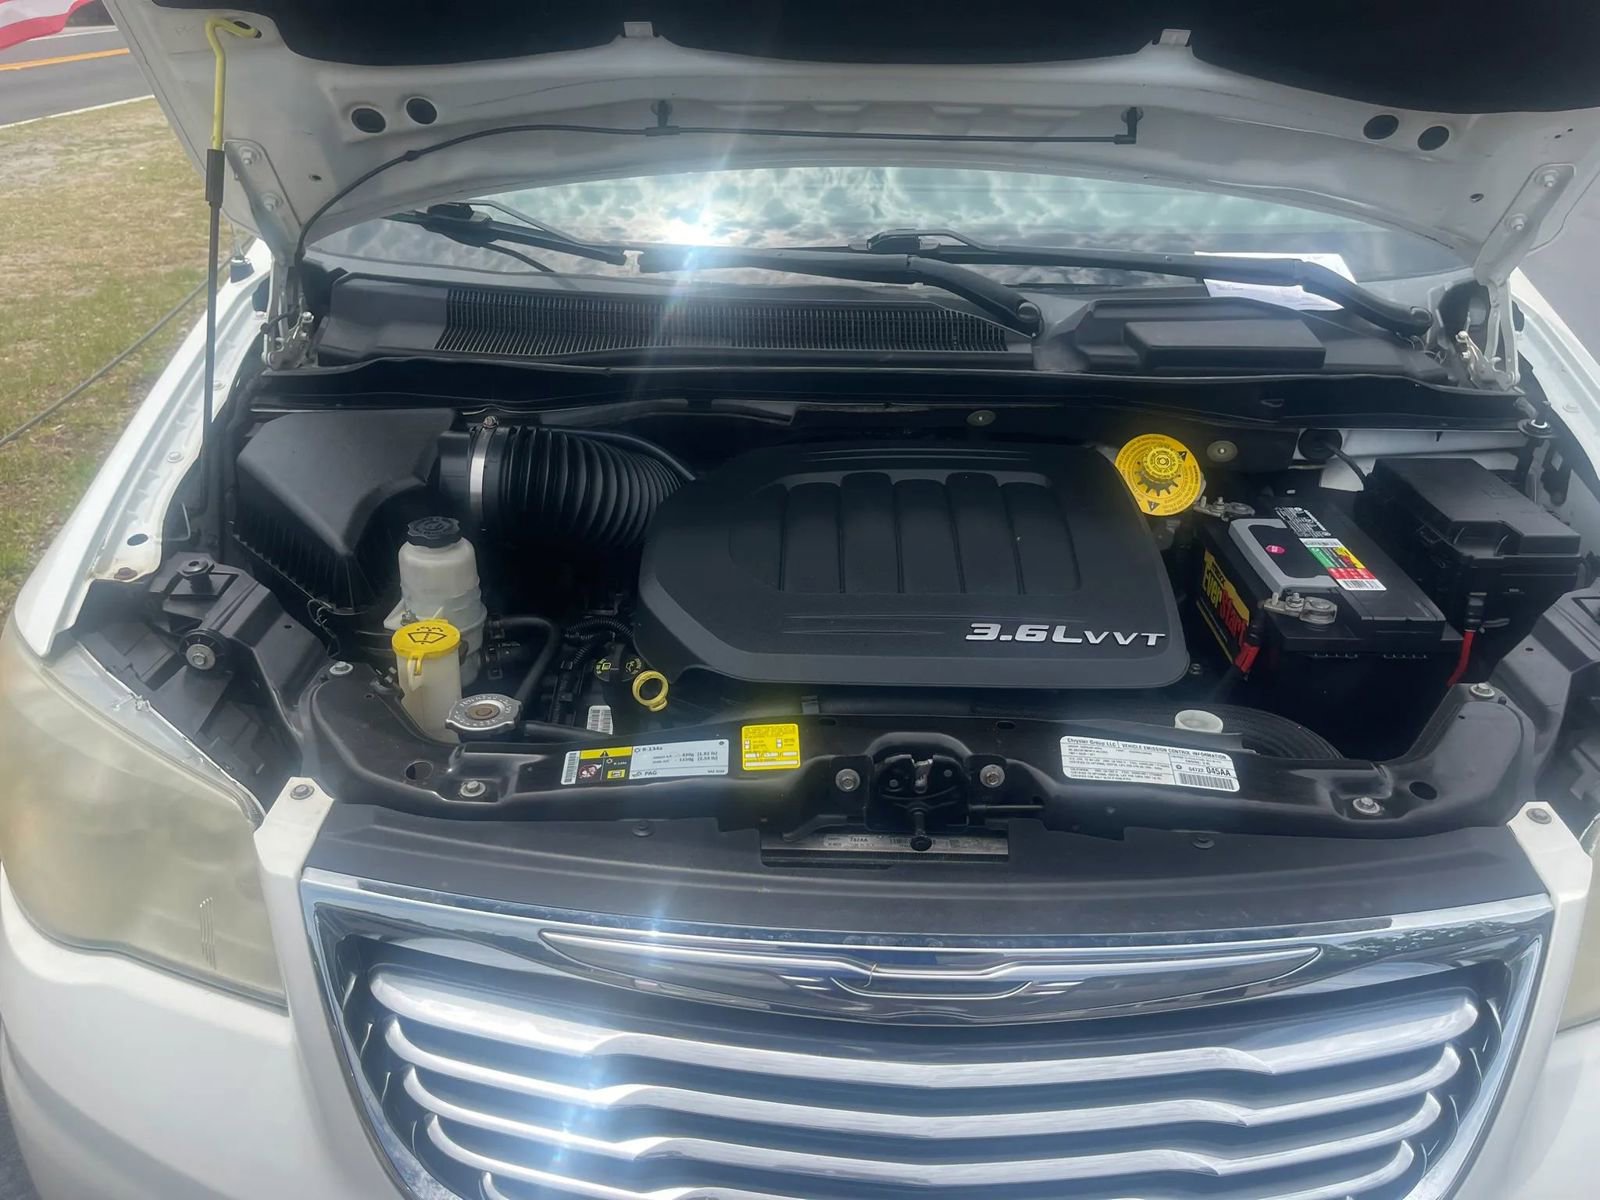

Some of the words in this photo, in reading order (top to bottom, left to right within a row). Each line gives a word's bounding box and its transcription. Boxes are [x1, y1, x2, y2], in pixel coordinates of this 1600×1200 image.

[965, 623, 1082, 643] 3.6L
[1083, 631, 1164, 645] VVT
[1090, 739, 1105, 747] Group
[1143, 745, 1168, 753] EMISSION
[1168, 748, 1190, 756] CONTROL
[1192, 751, 1227, 760] INFORMATION
